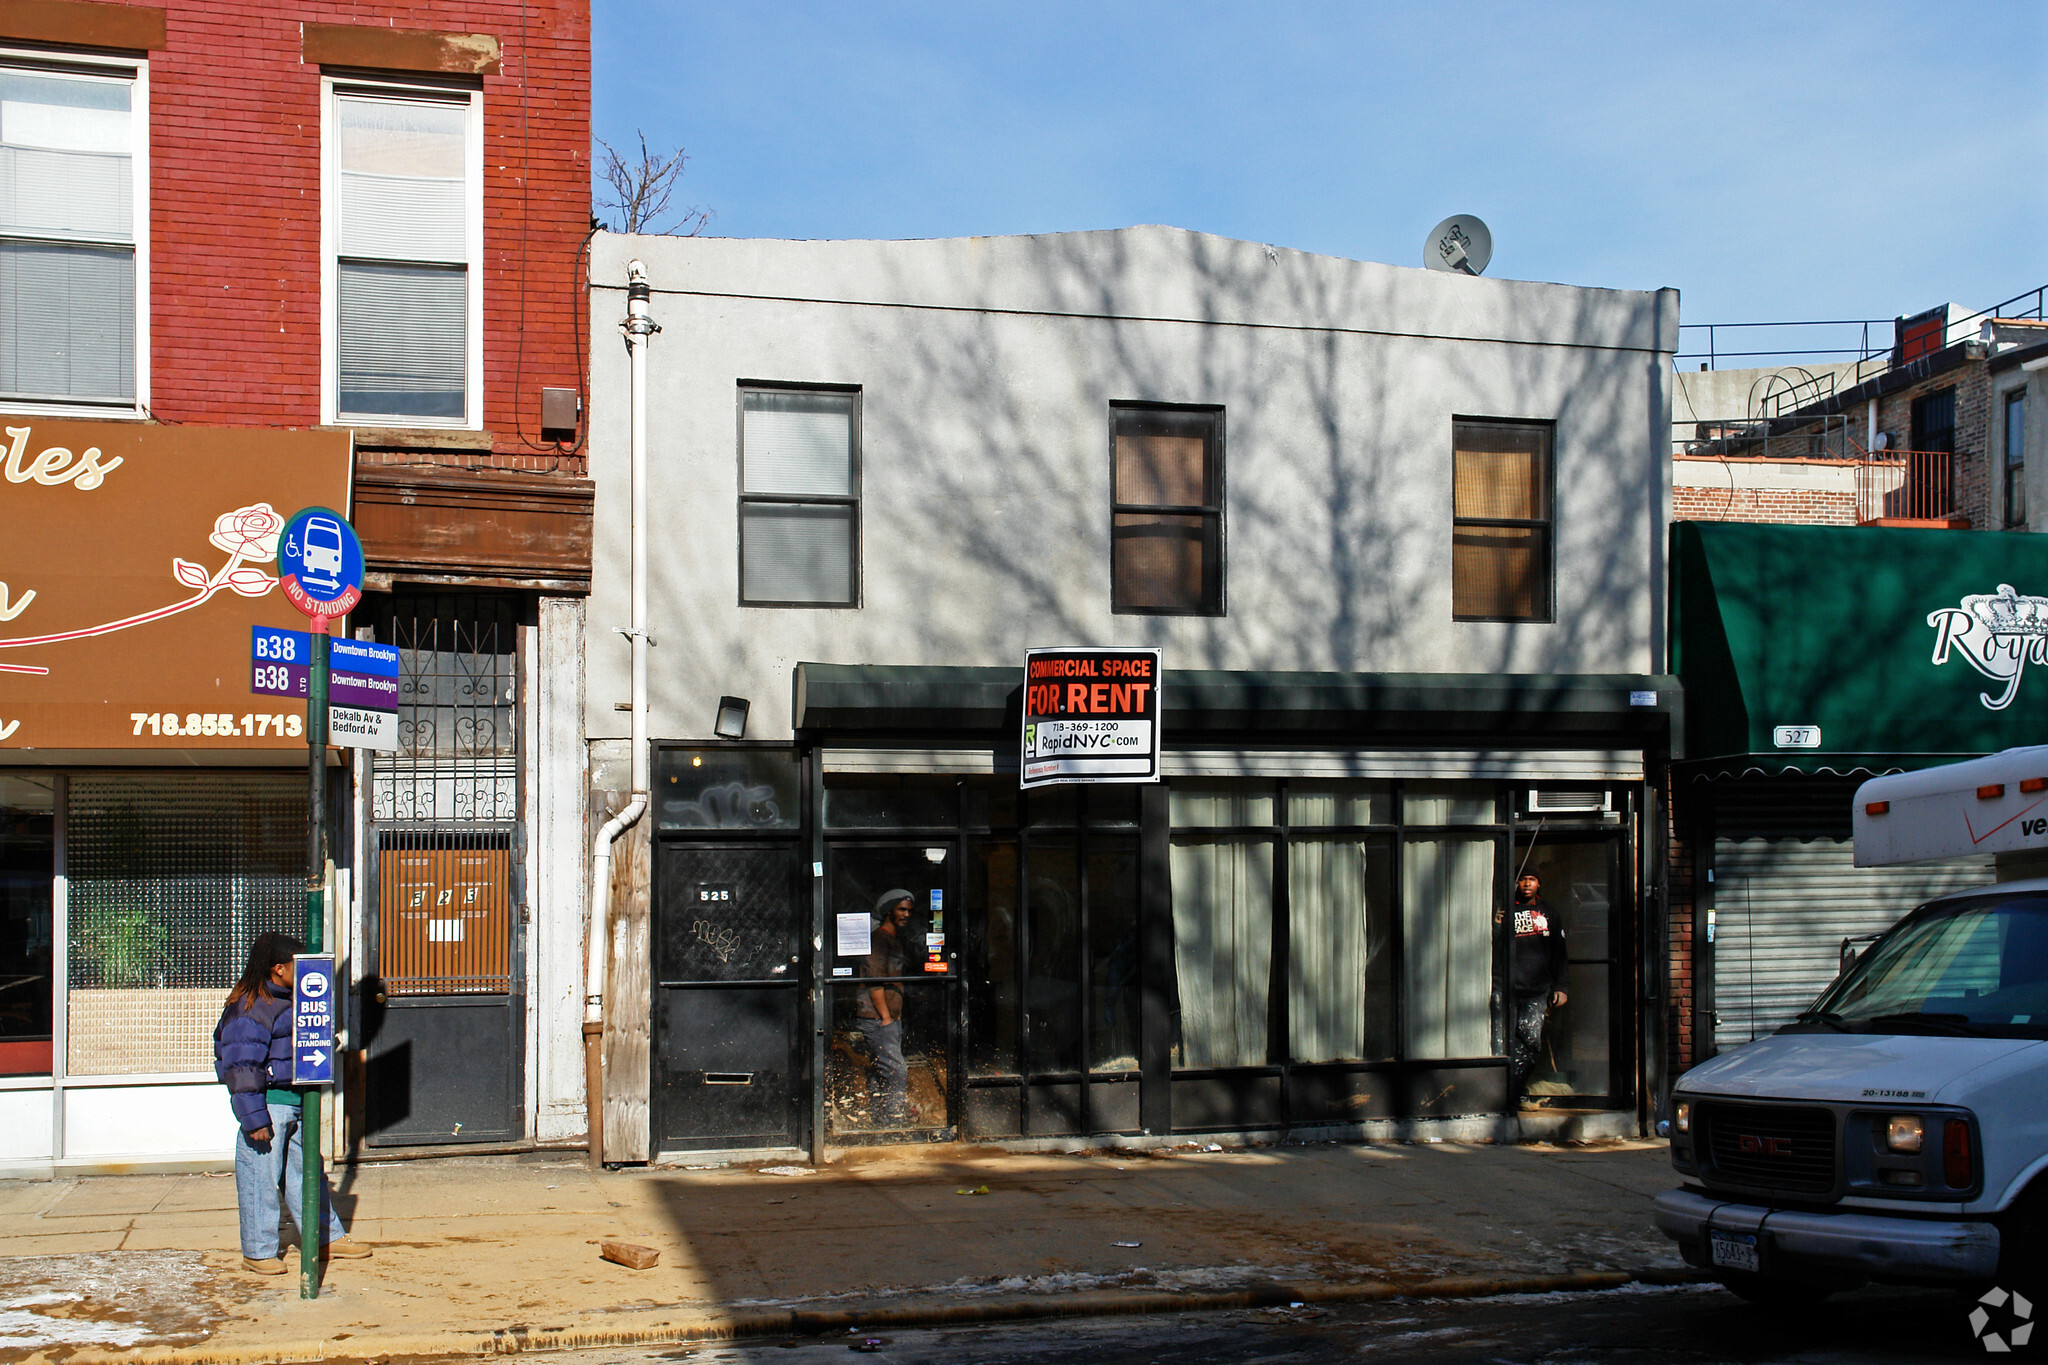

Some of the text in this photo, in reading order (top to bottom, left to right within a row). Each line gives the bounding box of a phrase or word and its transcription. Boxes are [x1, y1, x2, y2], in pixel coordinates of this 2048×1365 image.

[0, 426, 124, 490] les
[288, 581, 355, 615] NO STANDING
[256, 635, 295, 661] B38
[333, 642, 396, 663] Downtown Brooklyn
[1030, 659, 1151, 678] COMMERCIAL SPACE
[254, 665, 289, 690] B38
[299, 677, 307, 692] LTD
[331, 673, 397, 693] Downtown Brooklyn
[1027, 683, 1150, 716] FOR RENT
[130, 713, 303, 737] 718.855.1713
[332, 709, 382, 724] Dekalb Av &
[332, 722, 378, 735] Bedford Av
[1052, 722, 1119, 732] 718-369-1200
[1785, 730, 1810, 743] 527
[2022, 817, 2048, 837] ve
[700, 891, 729, 900] 525
[1514, 910, 1531, 920] THE
[301, 1001, 327, 1013] BUS
[297, 1015, 331, 1027] STOP
[297, 1040, 331, 1048] STANDING
[309, 1032, 319, 1040] NO
[1739, 1135, 1792, 1156] GMC
